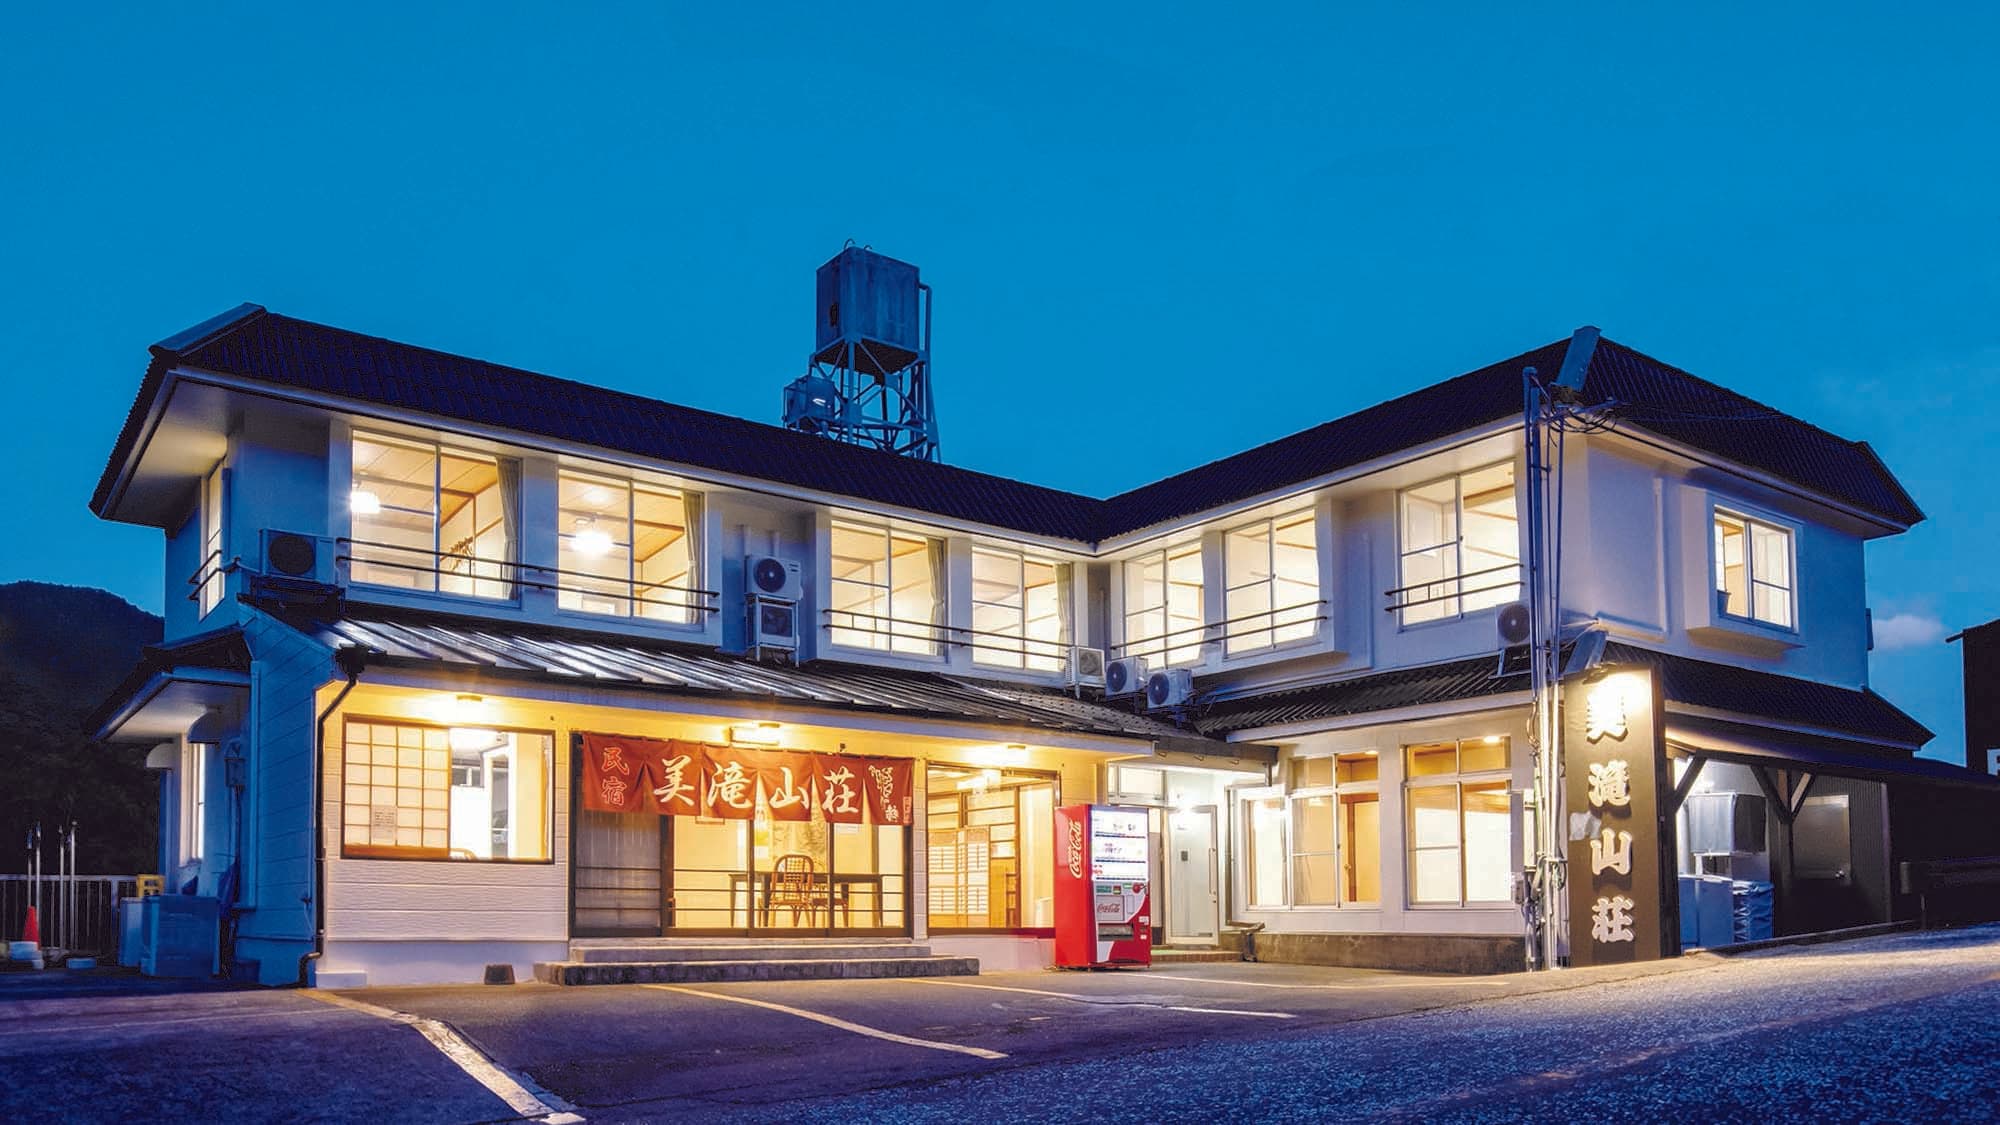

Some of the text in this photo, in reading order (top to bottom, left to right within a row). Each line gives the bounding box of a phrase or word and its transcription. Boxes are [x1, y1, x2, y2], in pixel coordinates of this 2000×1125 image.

[601, 747, 629, 804] 民宿
[654, 756, 859, 813] 美滝山荘
